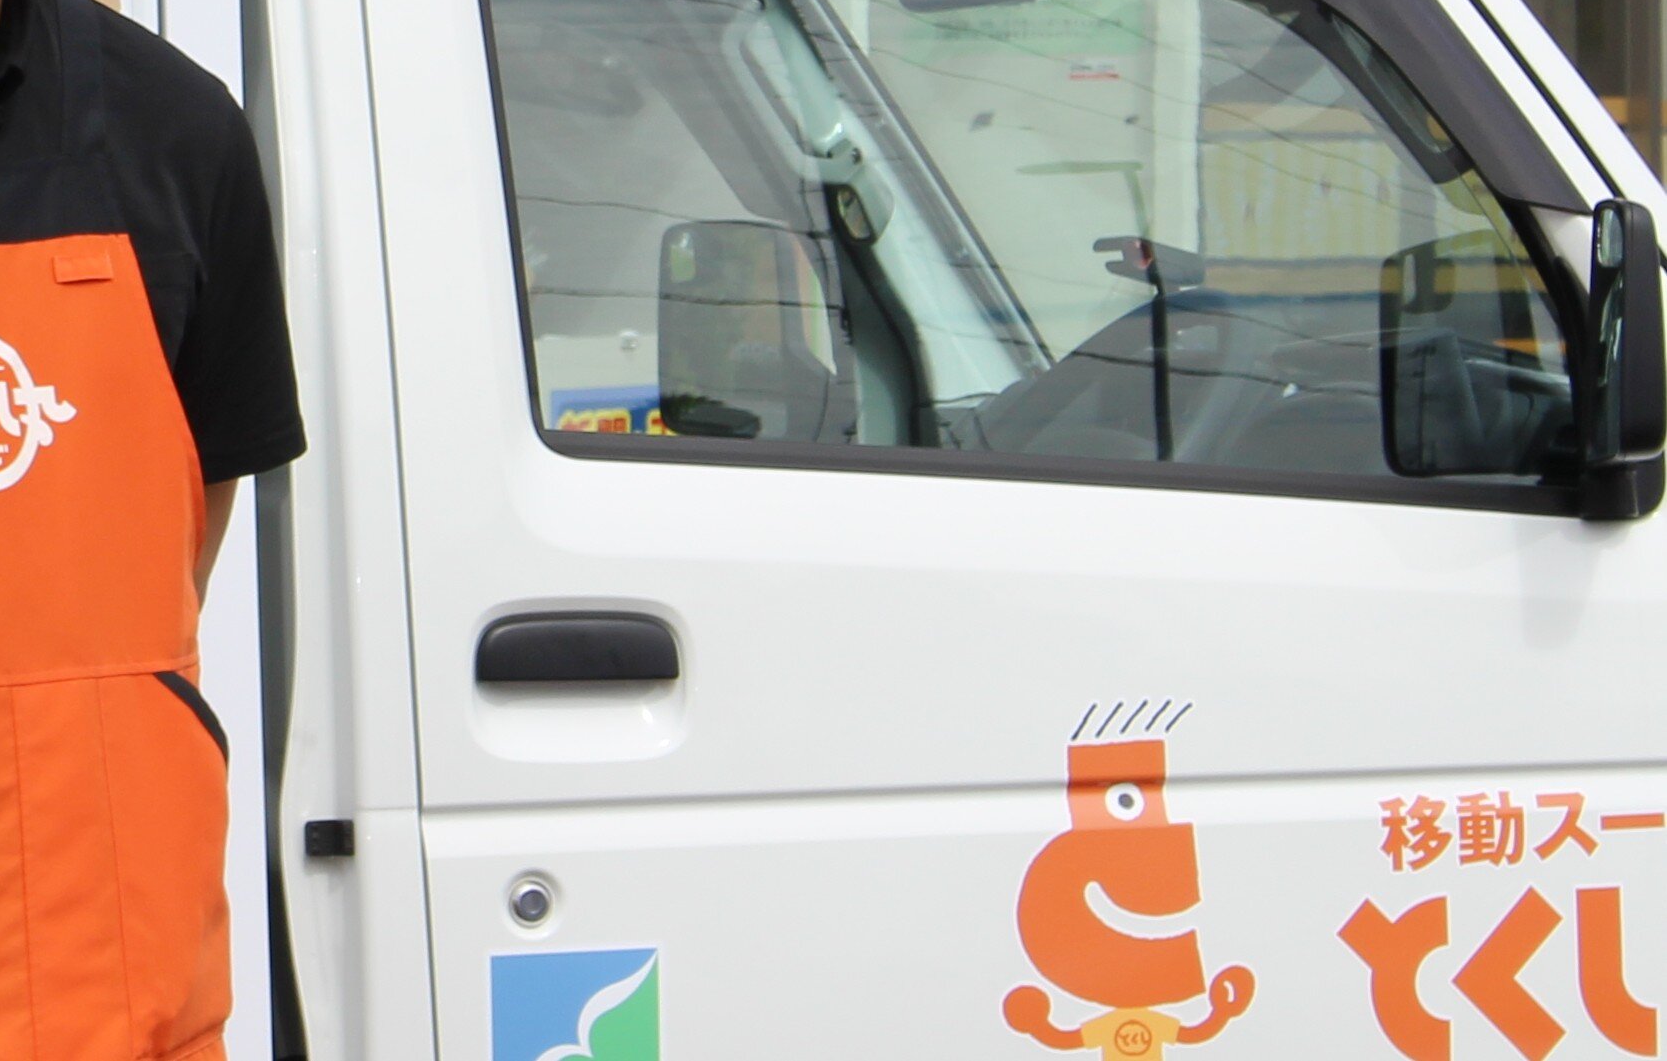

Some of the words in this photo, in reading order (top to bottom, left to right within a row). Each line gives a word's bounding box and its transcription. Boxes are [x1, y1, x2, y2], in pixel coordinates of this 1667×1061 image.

[1380, 791, 1665, 871] 移動スー
[1336, 885, 1659, 1061] とくし
